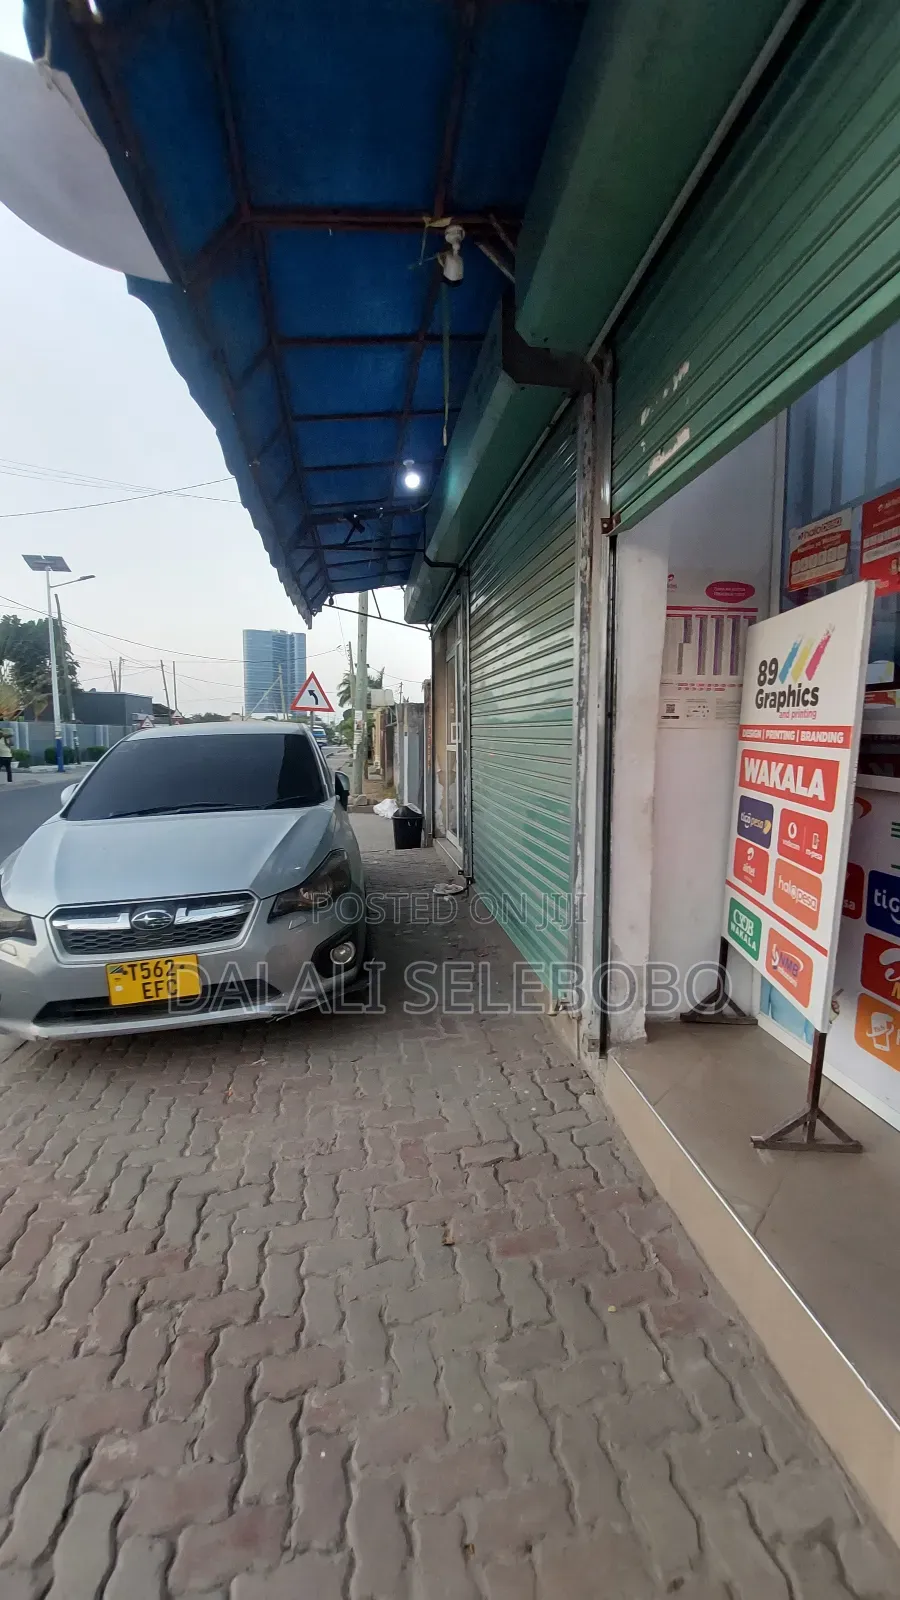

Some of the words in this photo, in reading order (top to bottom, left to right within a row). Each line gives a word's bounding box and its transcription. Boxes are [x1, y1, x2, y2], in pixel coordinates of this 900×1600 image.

[757, 657, 779, 687] 89
[755, 682, 819, 712] Graphics
[779, 709, 790, 719] and
[791, 709, 817, 720] printing
[742, 728, 762, 739] DESIGN
[766, 729, 795, 741] PRINTING
[800, 730, 844, 744] BRANDING
[744, 756, 826, 801] WAKALA
[742, 862, 756, 878] airtel
[730, 921, 757, 952] WAKALA
[127, 959, 176, 981] T562
